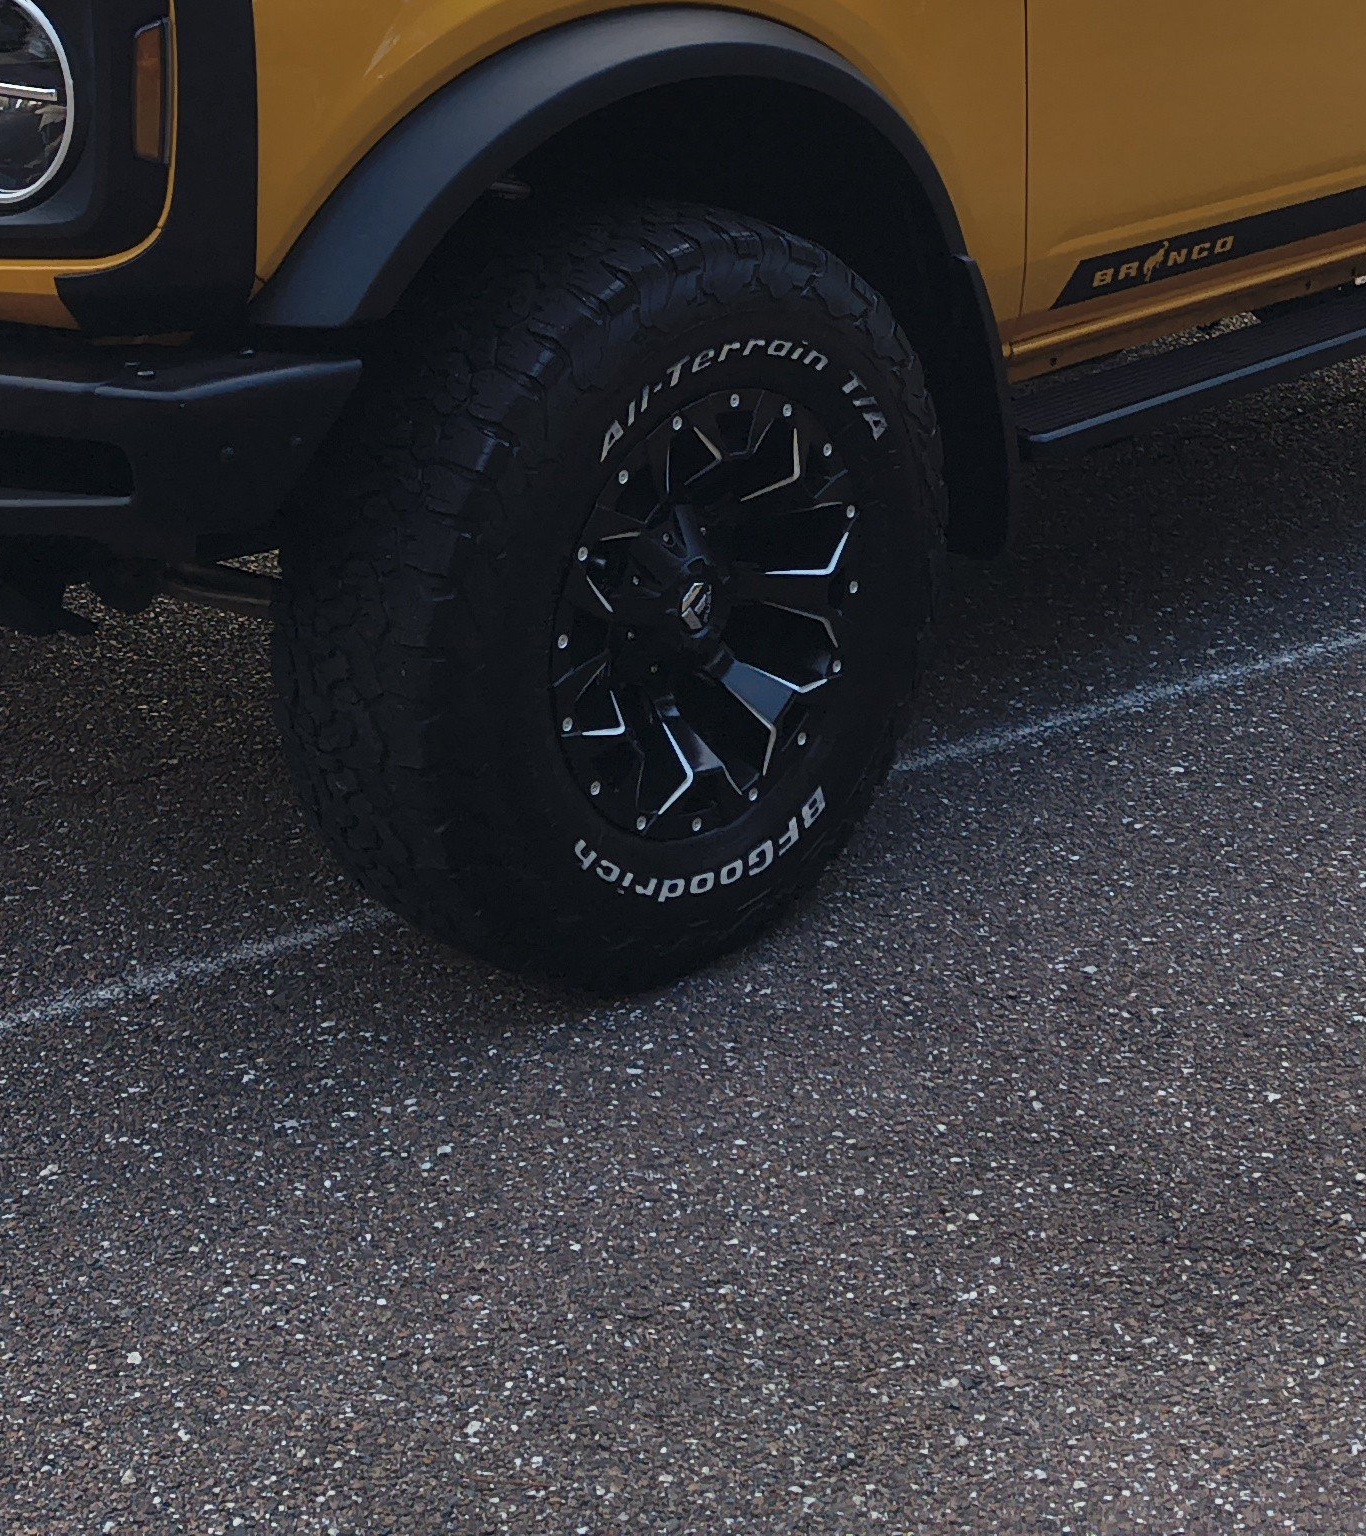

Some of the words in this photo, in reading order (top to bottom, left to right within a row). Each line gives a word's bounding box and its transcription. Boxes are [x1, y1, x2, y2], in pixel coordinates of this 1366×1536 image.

[600, 338, 829, 462] All-Terrain
[842, 369, 888, 441] T/A
[573, 785, 827, 903] BFGoodrich
